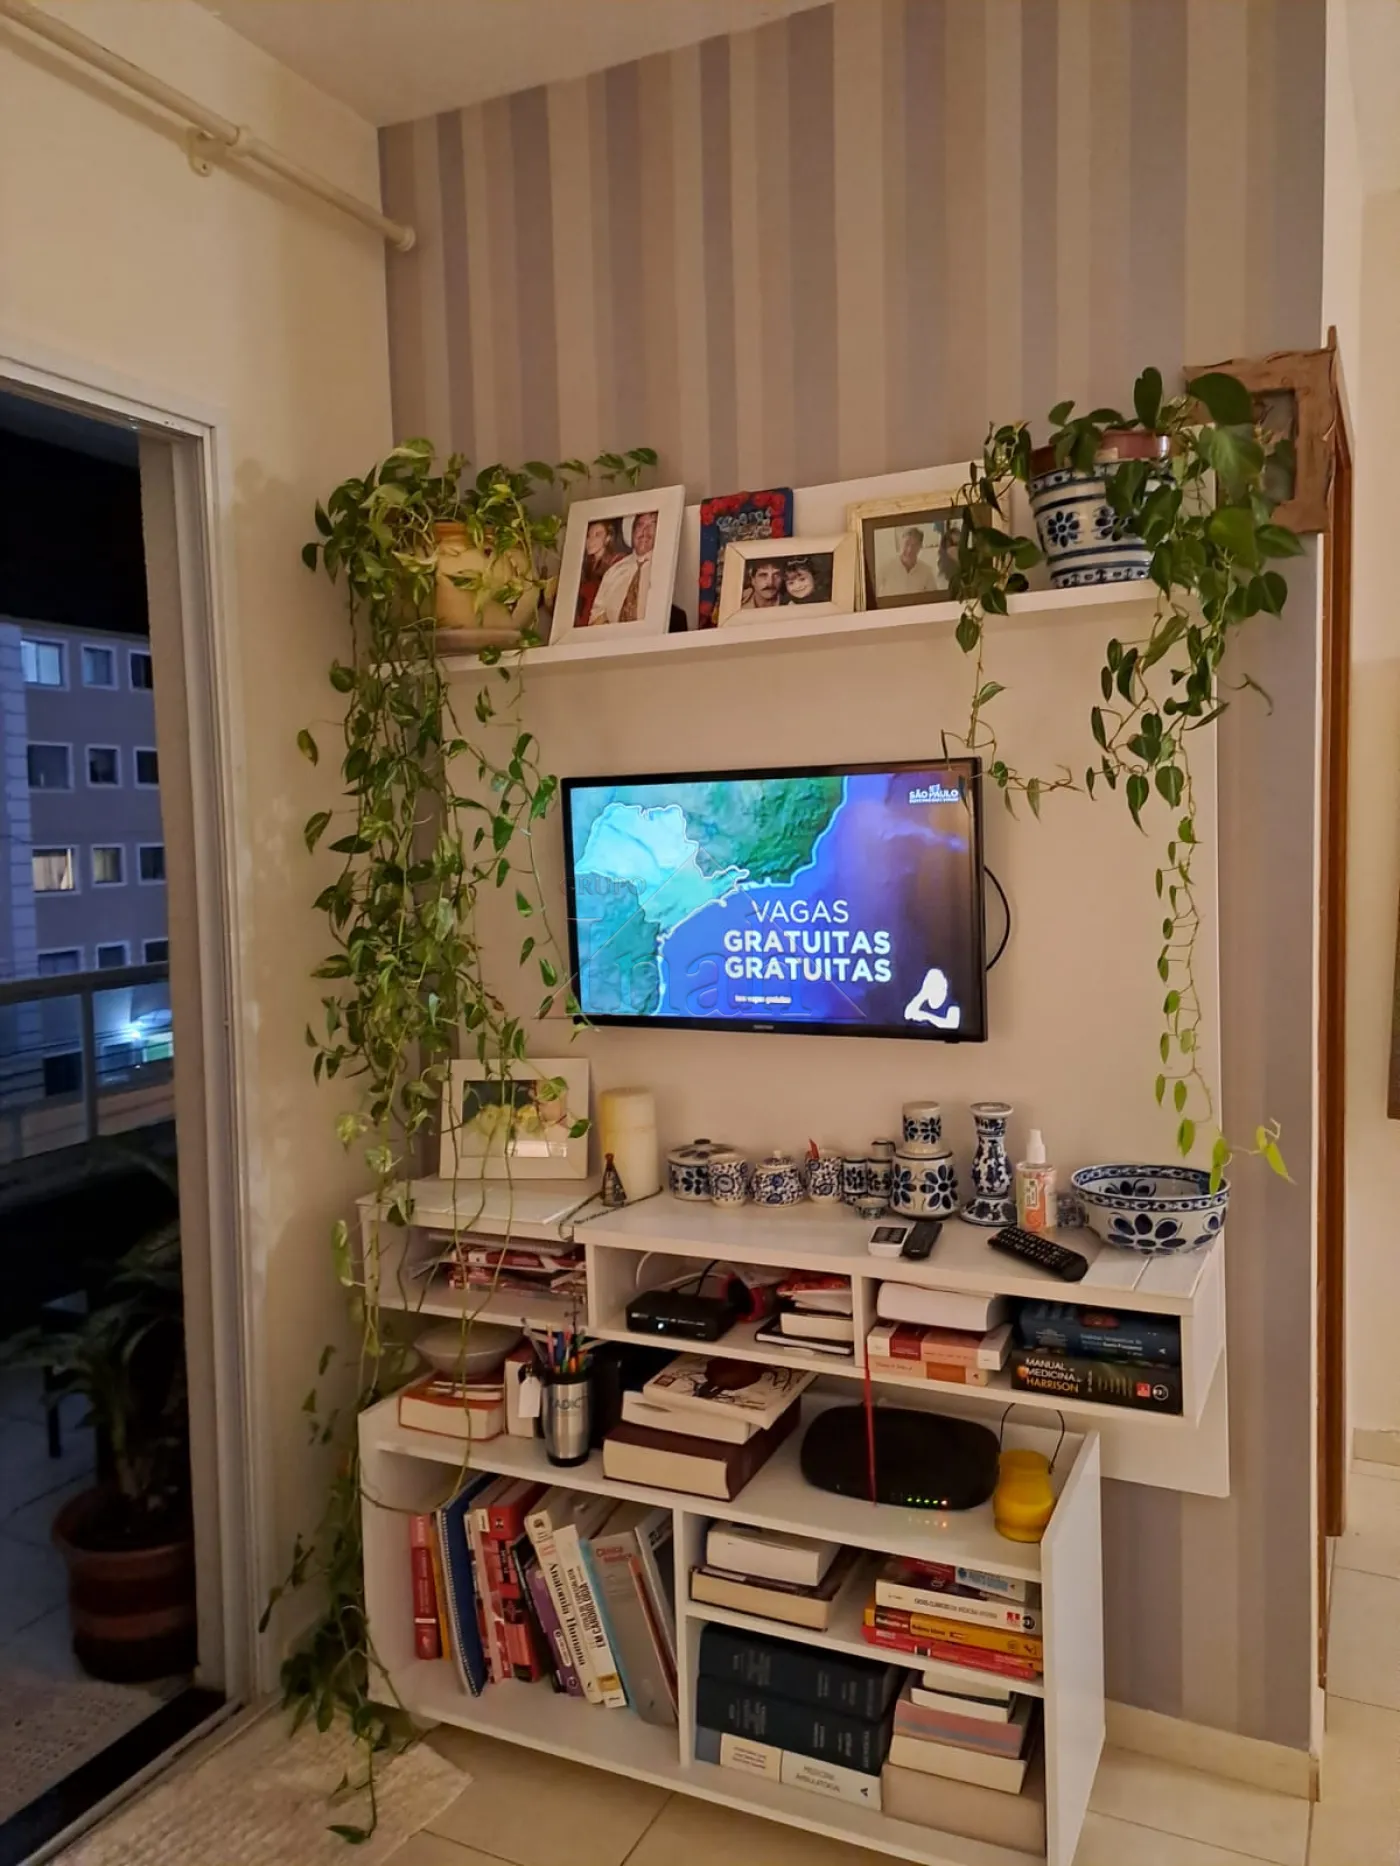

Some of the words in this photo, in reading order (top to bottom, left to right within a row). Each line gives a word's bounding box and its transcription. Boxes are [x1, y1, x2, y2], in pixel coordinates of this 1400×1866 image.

[751, 899, 849, 924] VAGAS
[723, 929, 892, 955] GRATUITAS
[724, 956, 892, 983] GRATUITAS
[1025, 1357, 1066, 1371] MANUAL
[1027, 1367, 1076, 1382] MEDICINA
[1026, 1377, 1079, 1393] HARRISON
[547, 1561, 571, 1616] Anatomia
